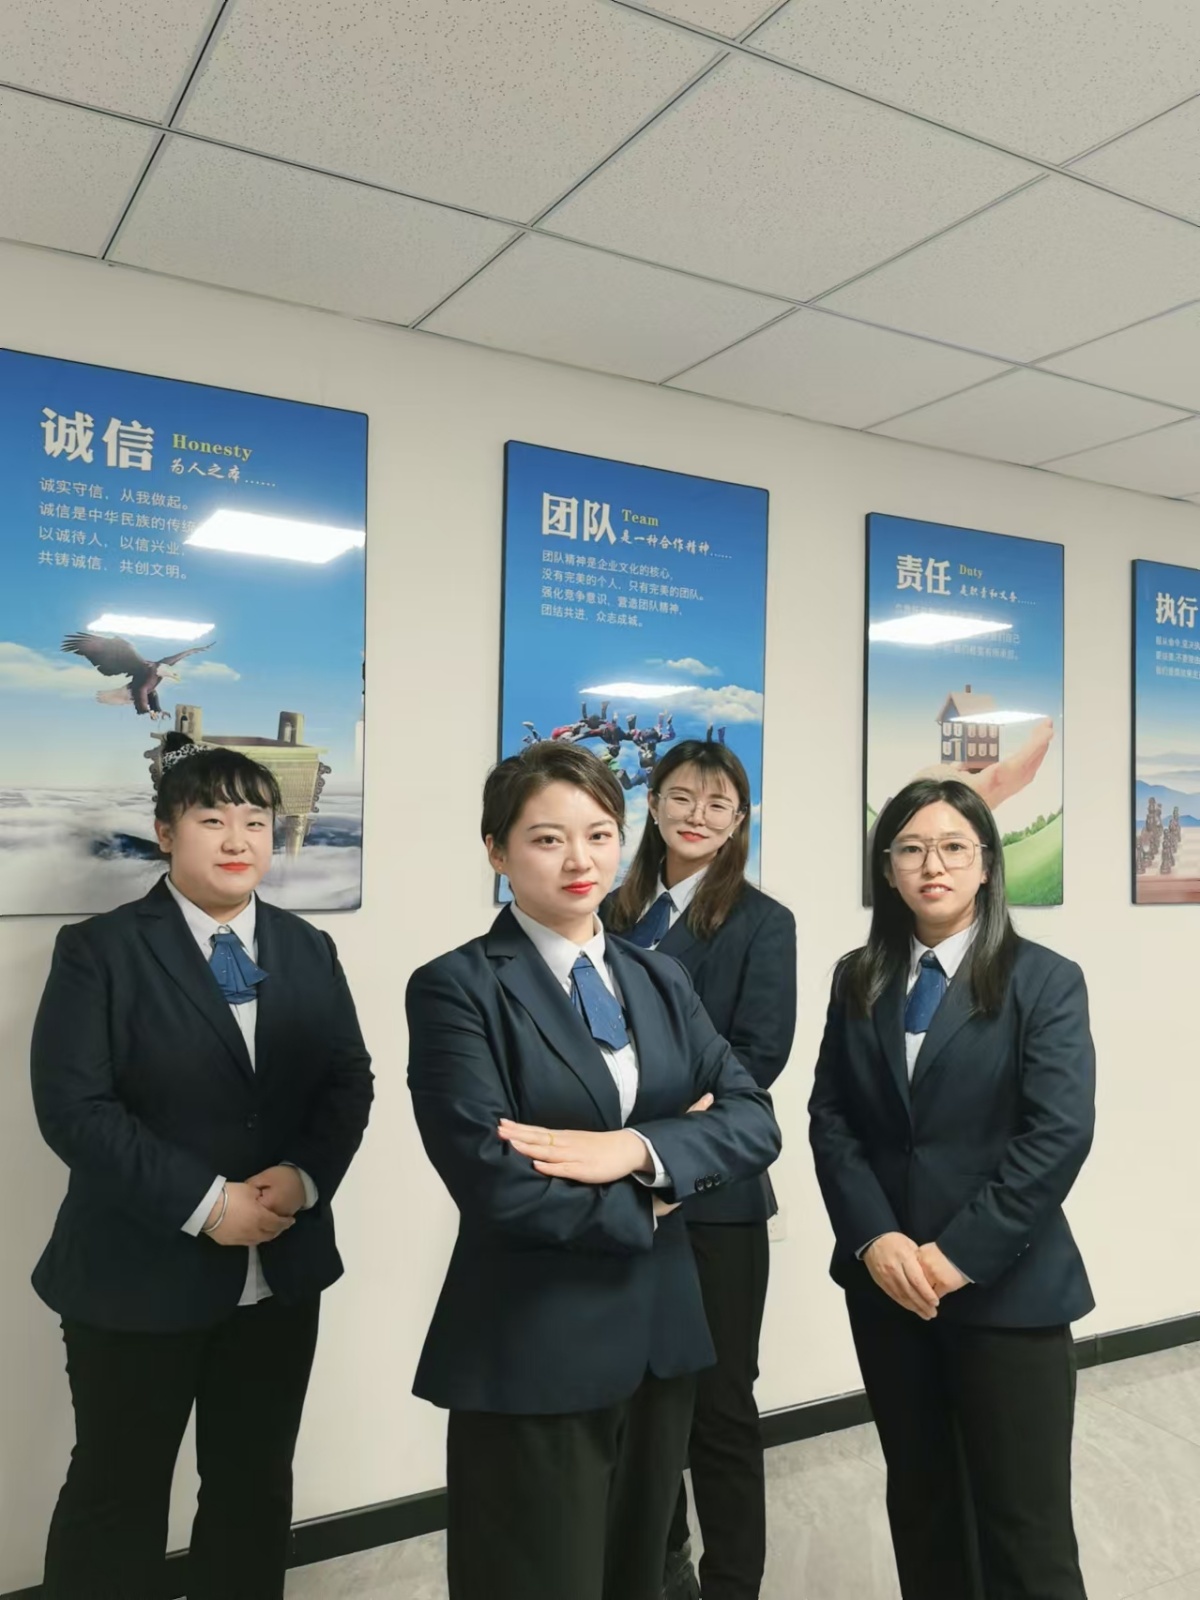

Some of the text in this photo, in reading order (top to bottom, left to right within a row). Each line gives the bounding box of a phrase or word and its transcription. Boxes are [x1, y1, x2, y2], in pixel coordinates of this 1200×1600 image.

[40, 406, 155, 471] 诚信
[172, 433, 253, 461] Honesty
[541, 492, 617, 545] 团队
[622, 508, 659, 527] Team
[896, 554, 951, 596] 责任
[959, 564, 983, 580] Duty
[1155, 592, 1199, 628] 执行
